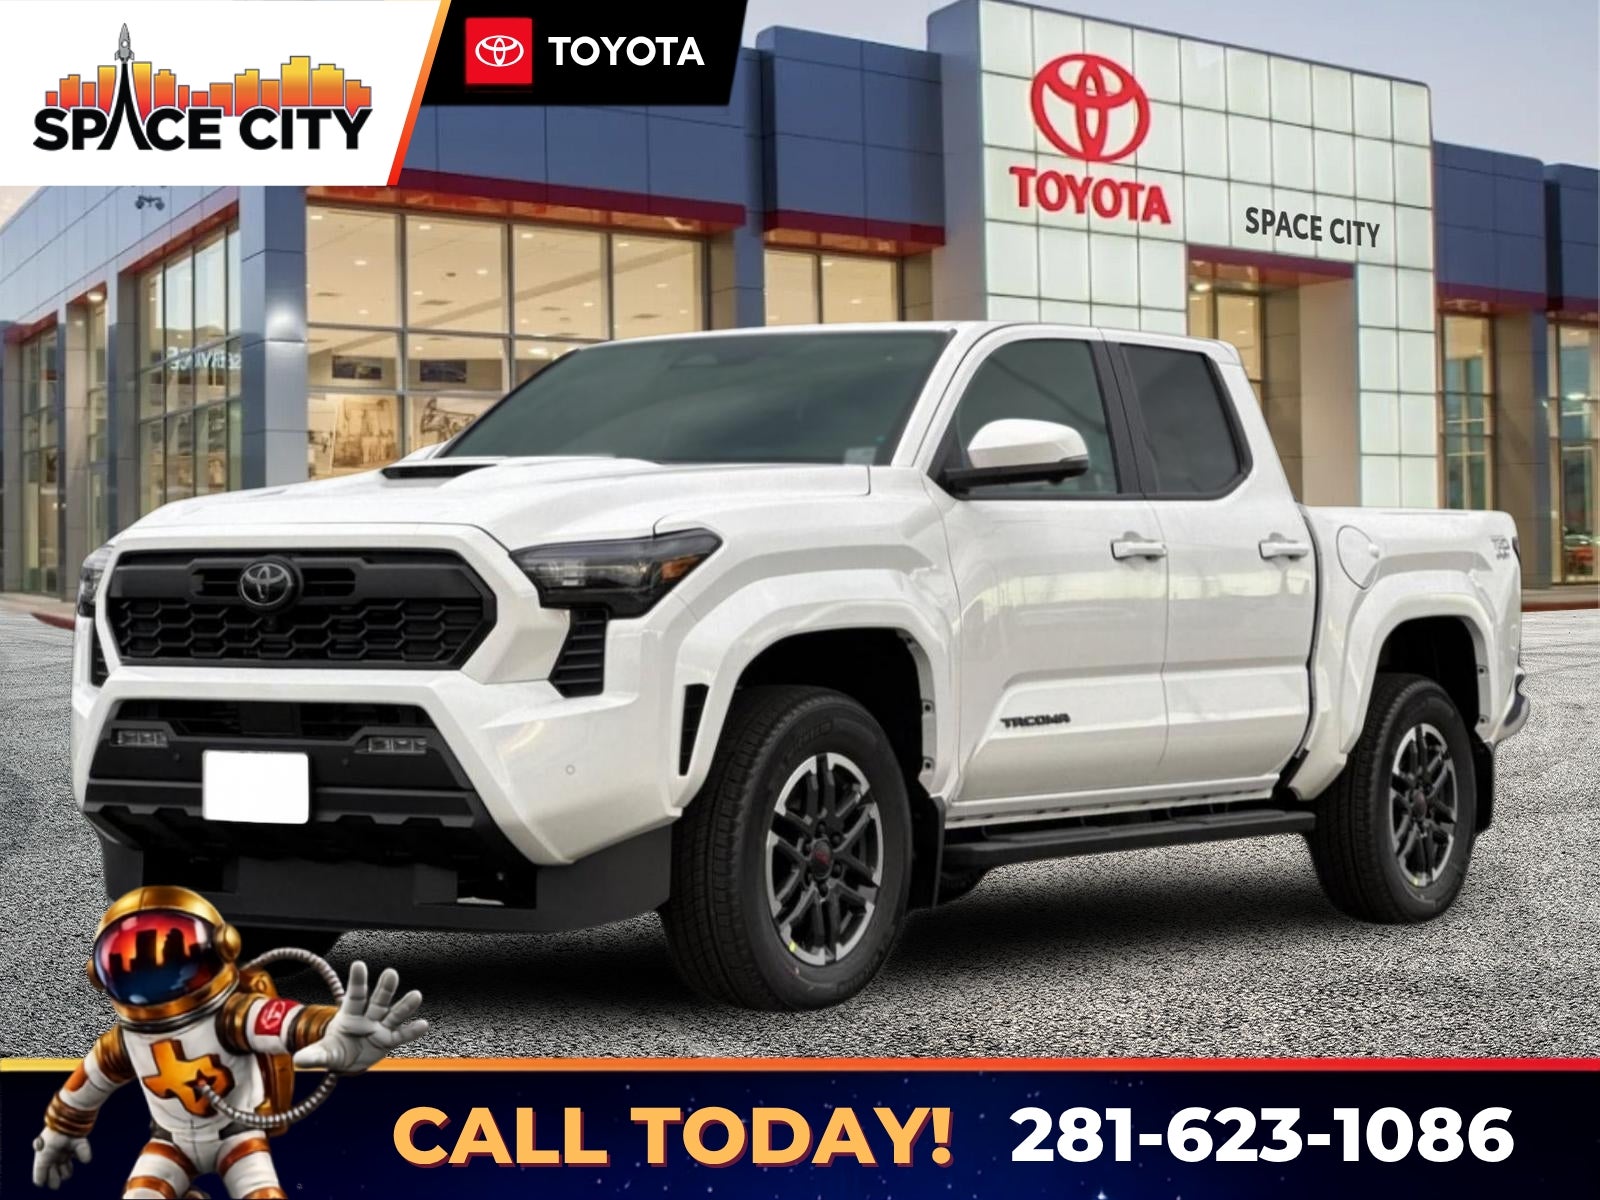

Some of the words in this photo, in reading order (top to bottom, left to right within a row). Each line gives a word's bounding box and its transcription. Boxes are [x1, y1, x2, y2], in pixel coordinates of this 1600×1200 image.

[1009, 166, 1171, 224] TOYOTA
[1245, 207, 1323, 242] SPACE
[1329, 217, 1381, 249] CITY
[1000, 713, 1071, 729] TACOMA
